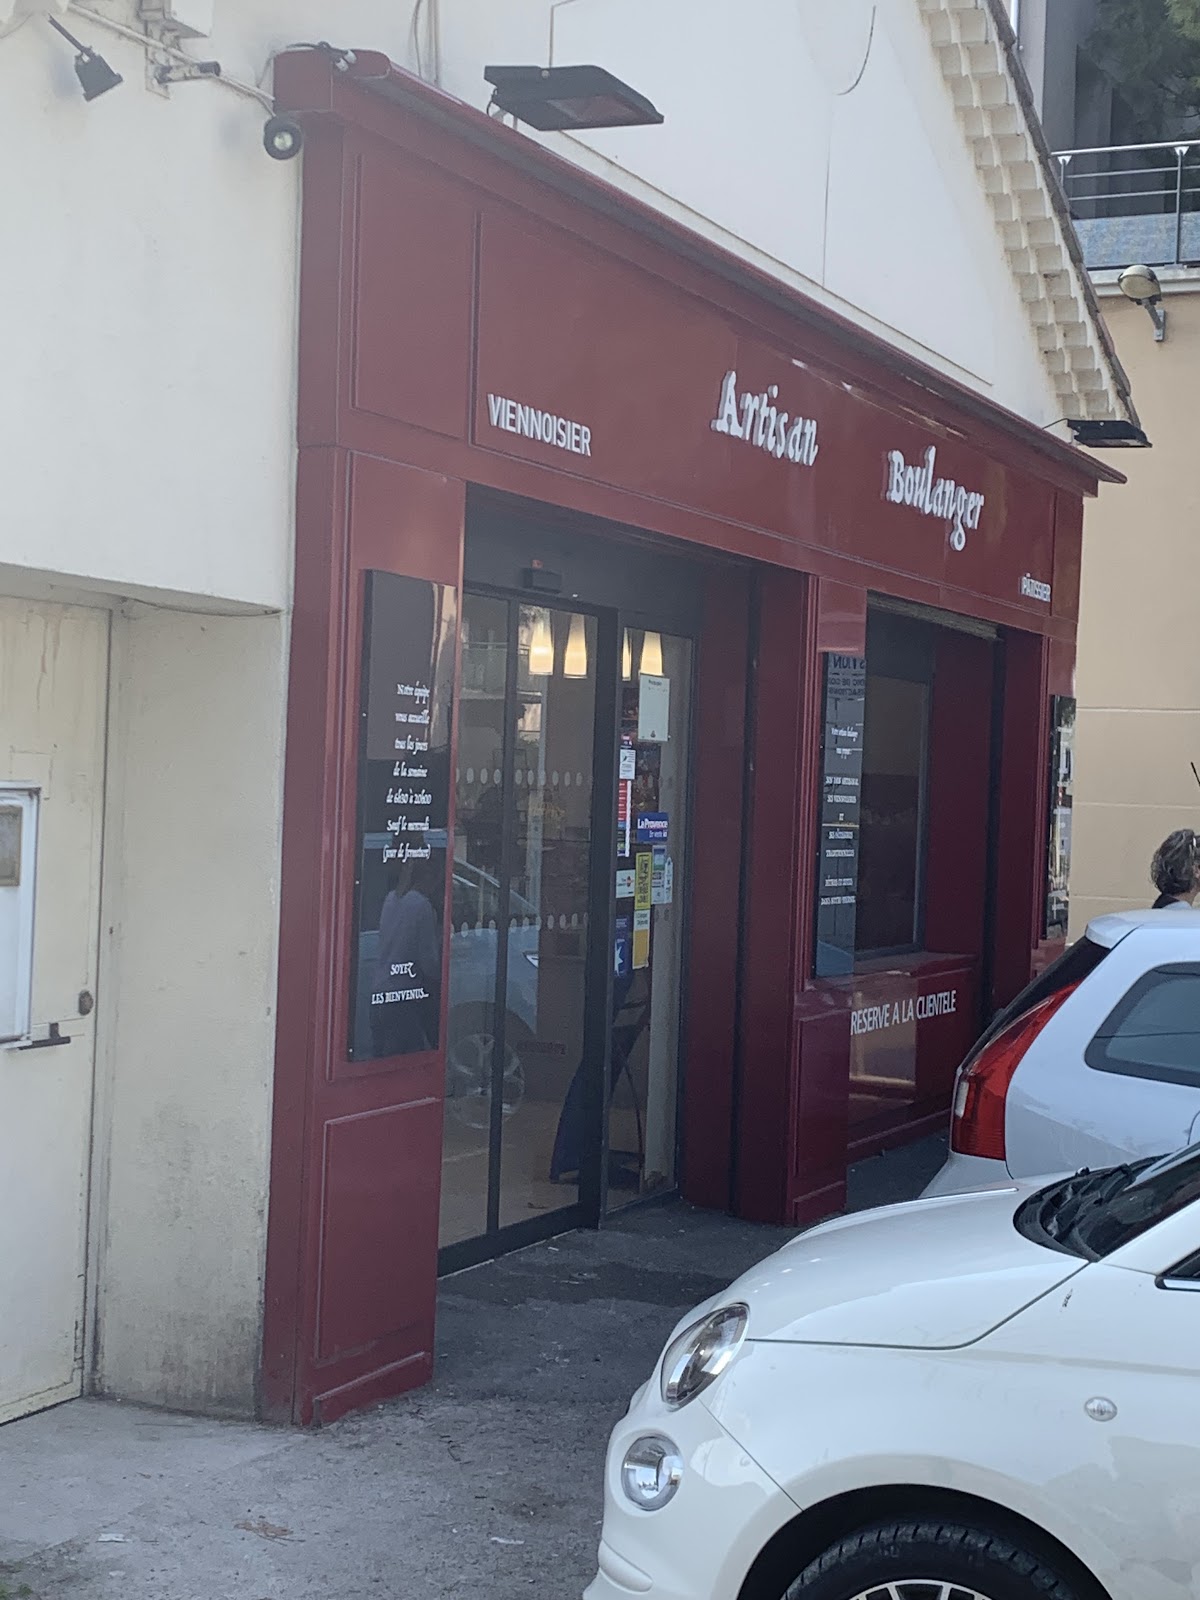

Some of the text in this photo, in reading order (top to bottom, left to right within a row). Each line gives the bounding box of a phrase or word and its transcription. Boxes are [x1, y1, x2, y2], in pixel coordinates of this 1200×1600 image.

[487, 393, 592, 457] VIENNOISIER
[711, 370, 819, 466] Artisan
[887, 445, 985, 551] Boulanger
[390, 961, 417, 978] SOYEZ
[371, 992, 385, 1005] LES
[850, 990, 957, 1035] RESERVE A LA CLIENTELE
